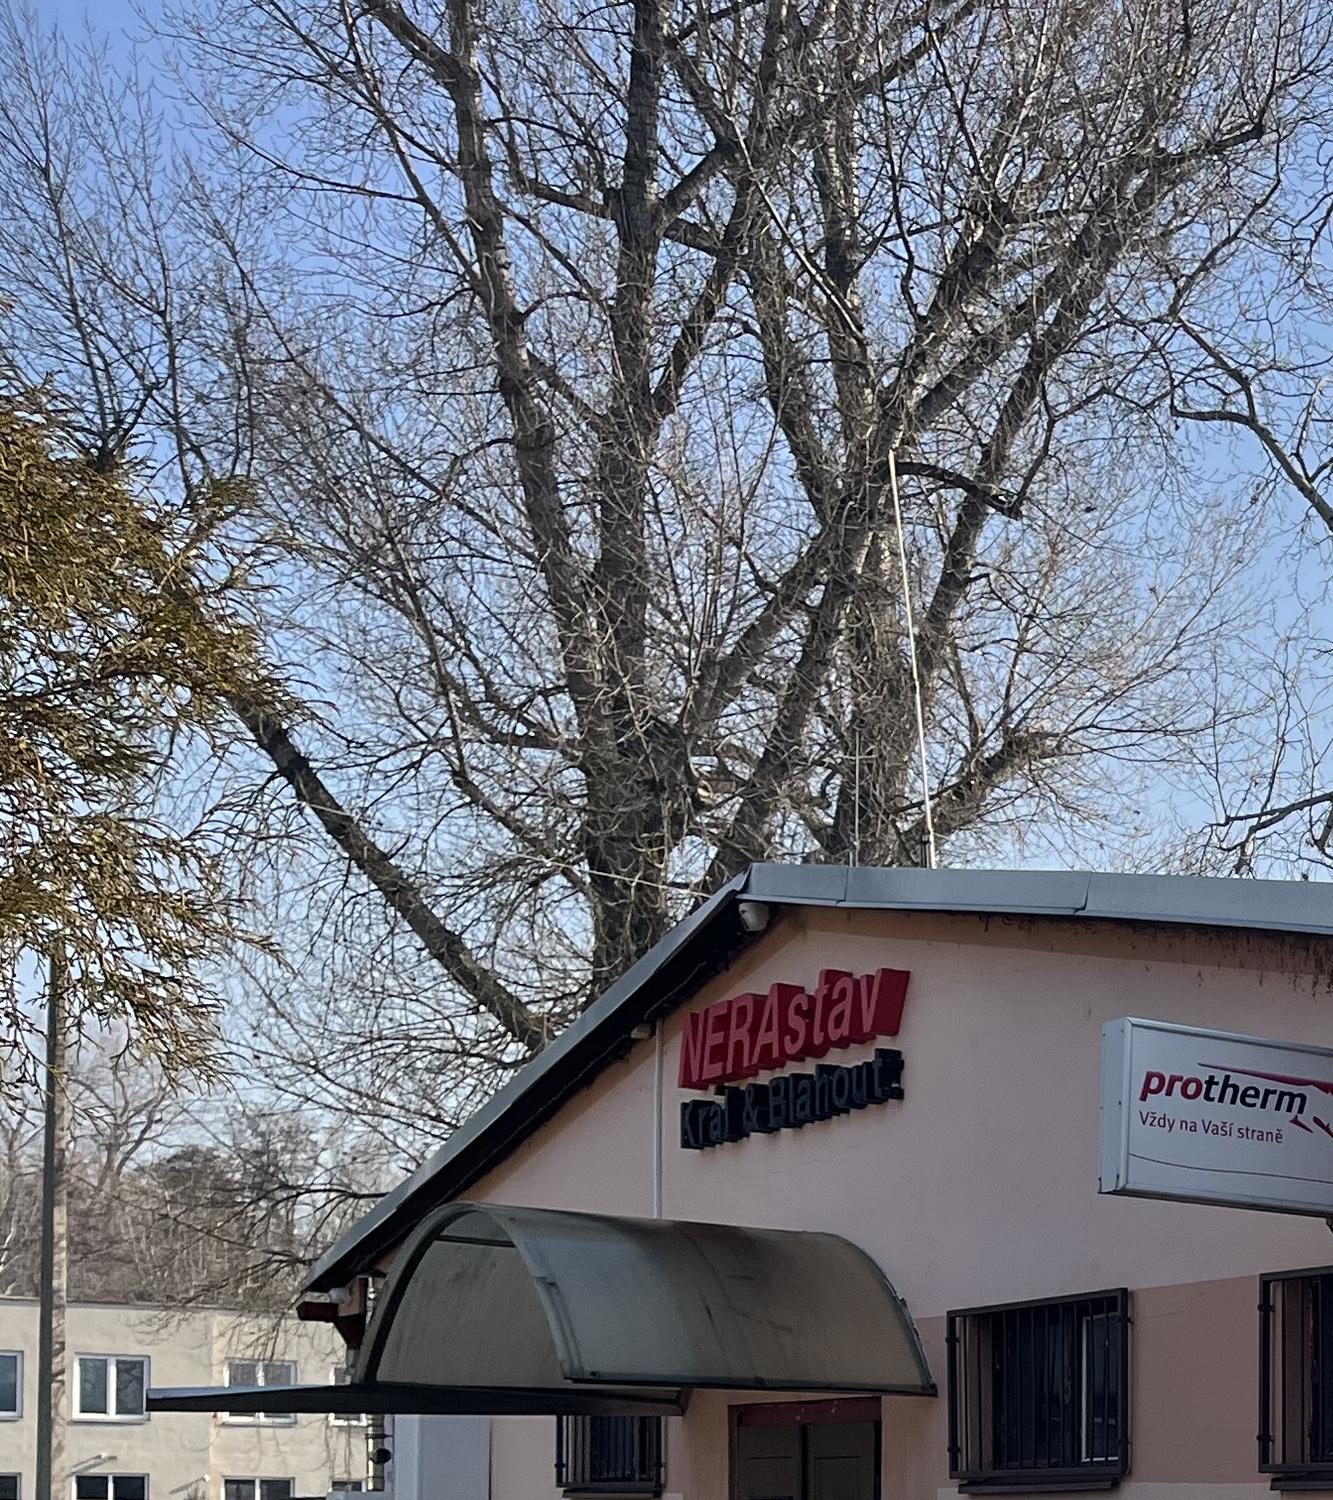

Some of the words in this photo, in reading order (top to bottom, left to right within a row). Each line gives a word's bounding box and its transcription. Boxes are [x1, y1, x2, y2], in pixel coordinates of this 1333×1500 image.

[679, 969, 908, 1089] NERAstav
[1139, 1071, 1307, 1114] protherm
[1139, 1110, 1177, 1132] Vždy
[1180, 1120, 1197, 1132] na
[1201, 1119, 1234, 1137] Vaší
[1237, 1127, 1283, 1144] straně
